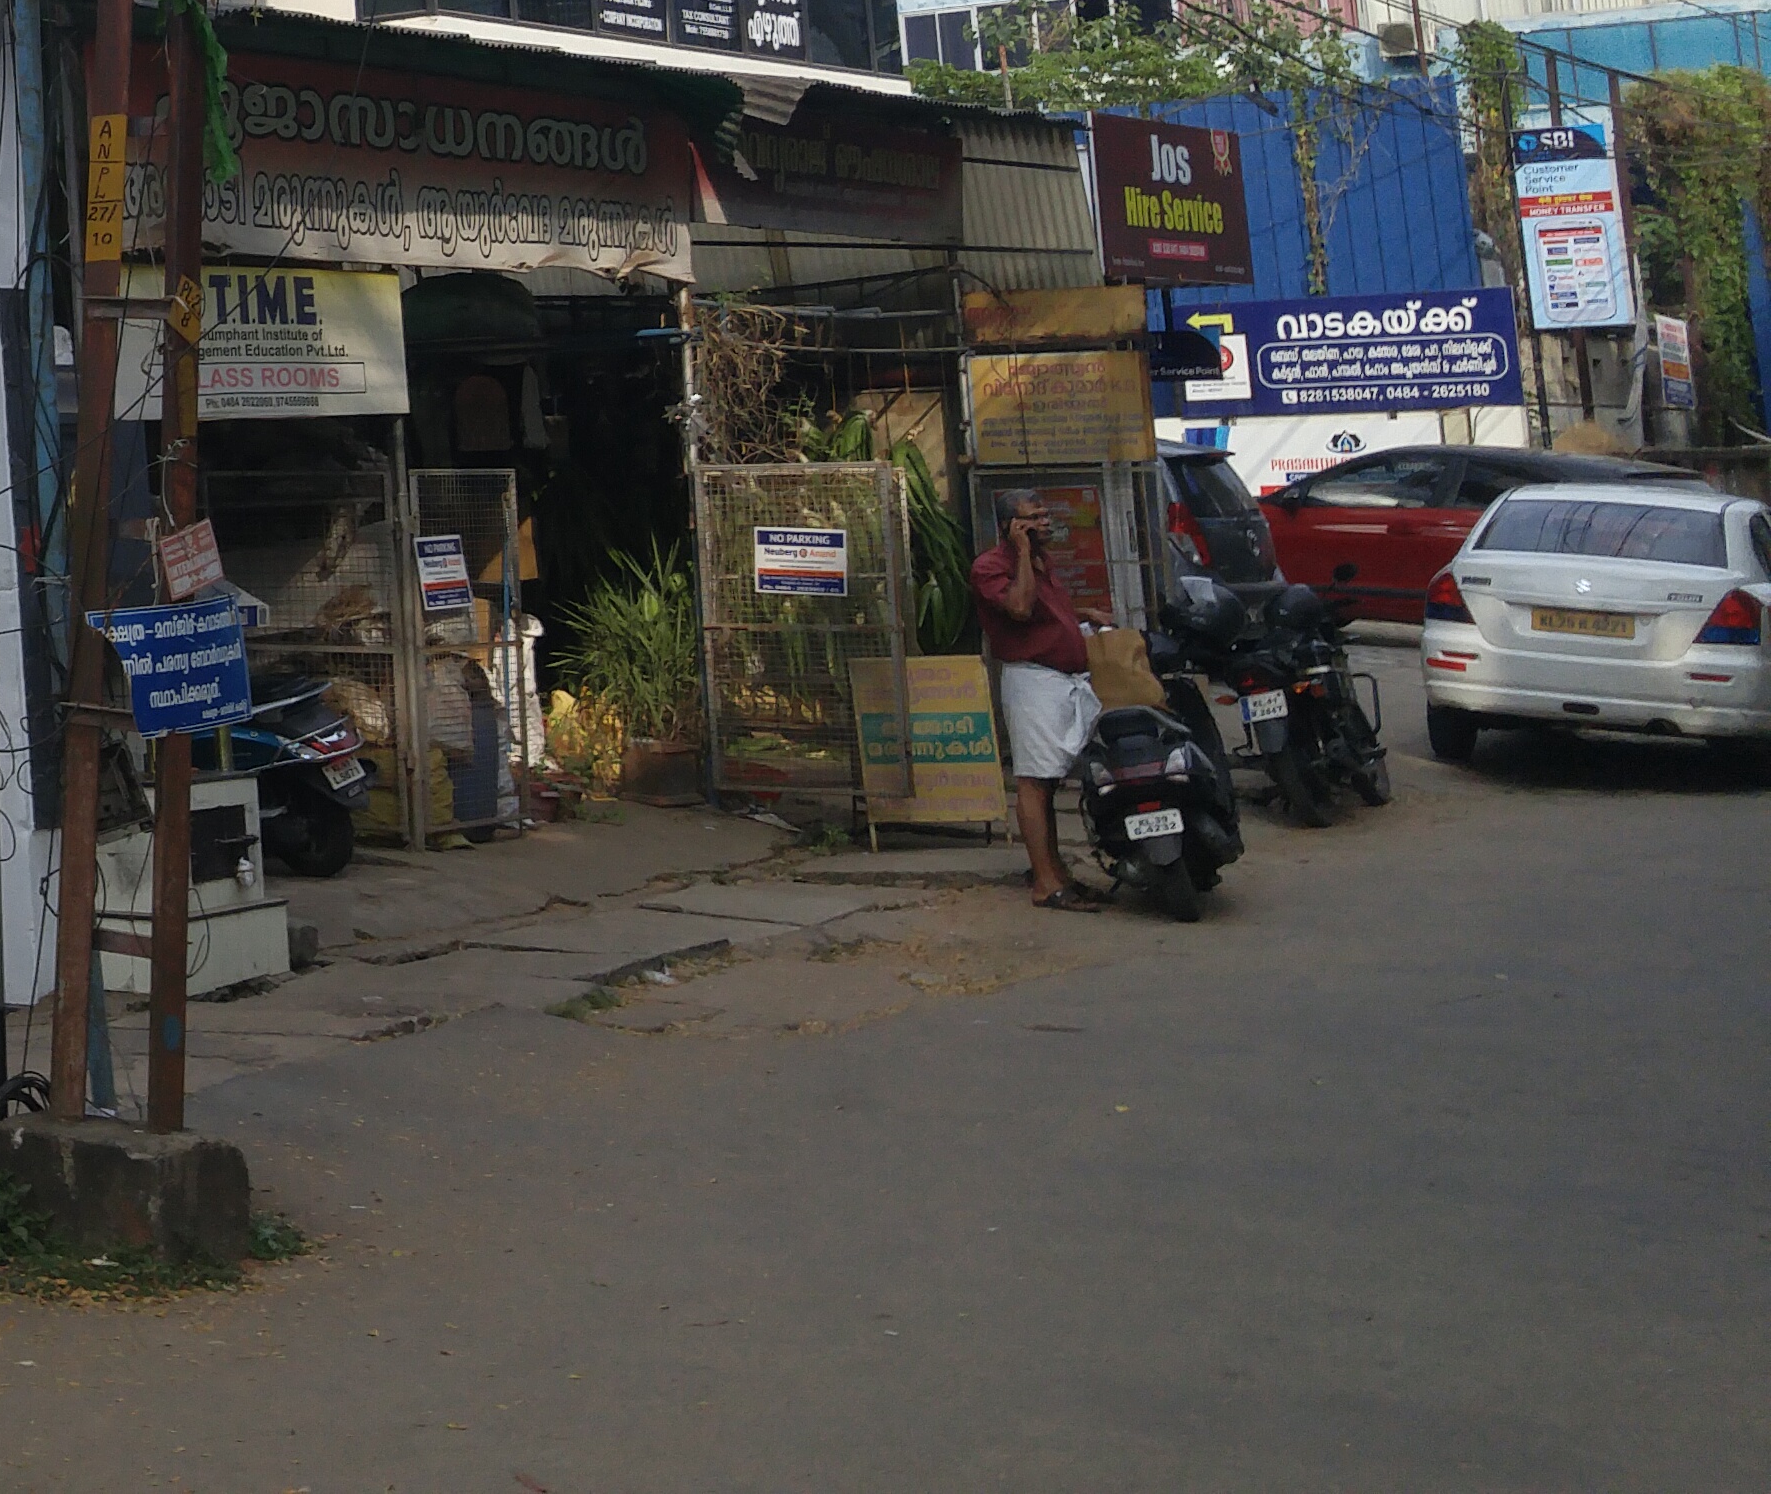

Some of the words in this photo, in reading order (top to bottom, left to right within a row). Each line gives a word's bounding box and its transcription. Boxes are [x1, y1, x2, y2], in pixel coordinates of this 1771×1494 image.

[1539, 130, 1576, 150] SBI
[1523, 164, 1580, 176] Customer
[1524, 175, 1566, 186] Service
[1525, 184, 1554, 194] Point
[1124, 186, 1161, 230] Hire
[1161, 189, 1225, 235] Service
[1529, 206, 1558, 217] MONEY
[1559, 203, 1606, 215] TRANSFER
[208, 273, 323, 327] T.I.M.E.
[261, 327, 309, 341] Institute
[311, 327, 324, 341] of
[198, 345, 242, 360] gement
[245, 344, 303, 358] Education
[306, 344, 350, 358] Pvt.Ltd.
[198, 367, 255, 389] LASS
[260, 367, 341, 389] ROOMS
[1386, 385, 1420, 400] 0484
[1431, 382, 1491, 399] 2625180
[768, 533, 785, 543] NO
[785, 533, 832, 545] PARKING
[763, 546, 798, 558] Neuberg
[155, 649, 190, 675] പരസ്യ
